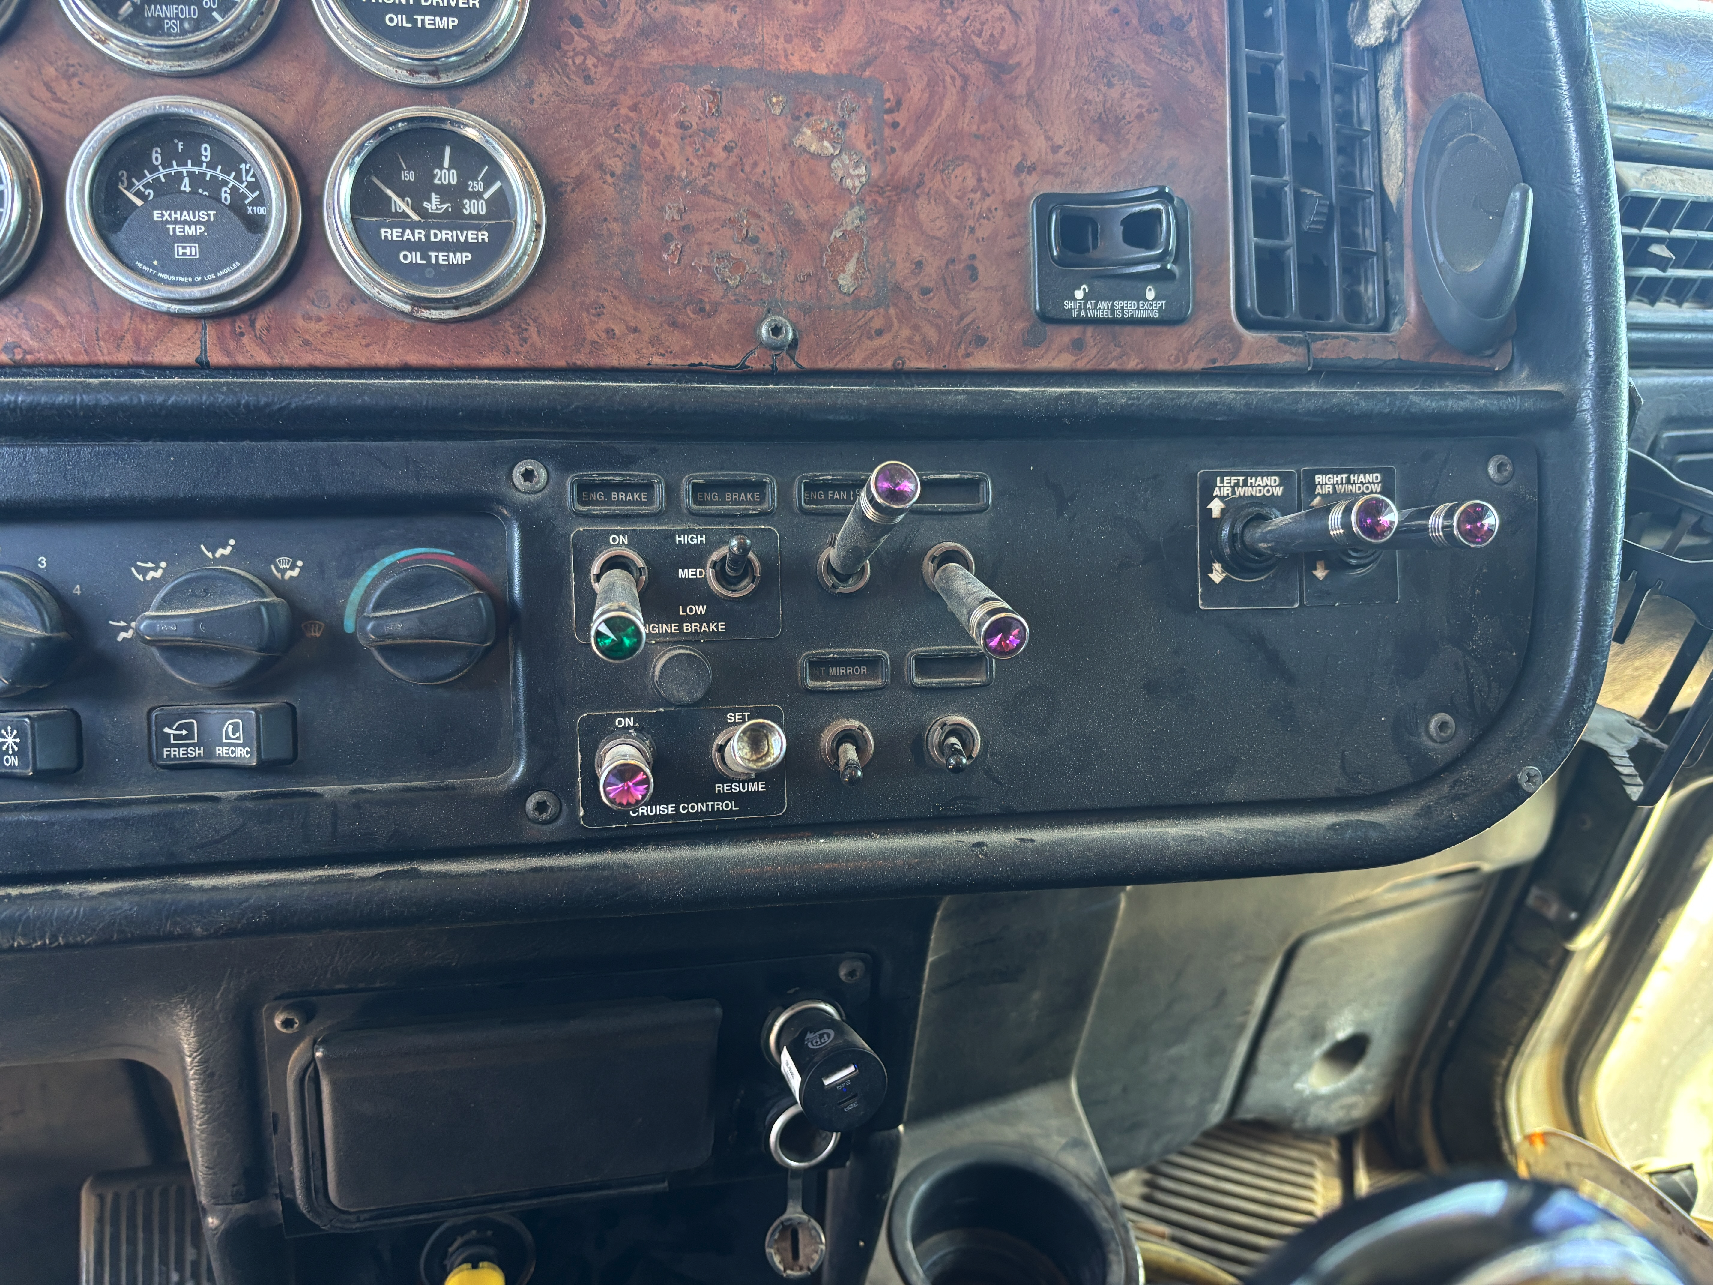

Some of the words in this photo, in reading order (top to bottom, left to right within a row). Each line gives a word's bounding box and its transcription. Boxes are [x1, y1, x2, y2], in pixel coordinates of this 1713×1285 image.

[144, 4, 199, 19] MANIFOLD
[164, 20, 180, 33] PSI
[385, 13, 412, 27] OIL
[413, 15, 459, 30] TEMP
[151, 147, 162, 166] 6
[201, 143, 211, 162] 9
[239, 162, 256, 182] 12
[401, 170, 415, 182] 150
[433, 168, 458, 185] 200
[118, 169, 128, 188] 3
[180, 176, 192, 193] 4
[468, 181, 484, 192] 250
[221, 187, 231, 205] 6
[247, 206, 267, 215] X100
[463, 199, 487, 215] 300
[153, 210, 217, 222] EXHAUST
[166, 224, 208, 236] TEMP.
[380, 228, 426, 242] REAR
[430, 229, 489, 243] DRIVER
[399, 251, 427, 264] OIL
[428, 252, 472, 265] TEMP
[1063, 300, 1085, 310] SHIFT
[1086, 300, 1096, 310] AT
[1096, 300, 1113, 310] ANY
[1113, 300, 1138, 310] SPEED
[1139, 300, 1166, 310] EXCEPT
[1072, 309, 1079, 318] IF
[1080, 309, 1086, 318] A
[1087, 309, 1113, 318] WHEEL
[1114, 309, 1122, 318] IS
[1123, 309, 1159, 318] SPINNING
[1216, 476, 1245, 487] LEFT
[1247, 476, 1280, 487] HAND
[1314, 474, 1347, 485] RIGHT
[1350, 473, 1381, 484] HAND
[804, 490, 825, 500] ENG
[828, 490, 847, 500] FAN
[1212, 486, 1232, 496] AIR
[1234, 486, 1284, 496] WINDOW
[1314, 484, 1333, 495] AIR
[1336, 483, 1382, 494] WINDOW
[582, 491, 608, 501] ENG.
[611, 491, 648, 502] BRAKE
[697, 492, 722, 502] ENG.
[725, 492, 760, 502] BRAKE
[609, 535, 628, 545] ON
[675, 535, 706, 544] HIGH
[37, 556, 48, 568] 3
[678, 569, 705, 579] MED
[72, 584, 82, 596] 4
[679, 605, 707, 616] LOW
[643, 623, 680, 634] NGINE
[683, 622, 726, 633] BRAKE
[829, 666, 867, 676] MIRROR
[615, 717, 634, 728] ON
[726, 712, 751, 723] SET
[163, 747, 204, 758] FRESH
[215, 747, 251, 758] RECIRC
[3, 755, 19, 767] ON
[715, 782, 767, 794] RESUME
[629, 804, 676, 816] CRUISE
[679, 800, 740, 814] CONTROL
